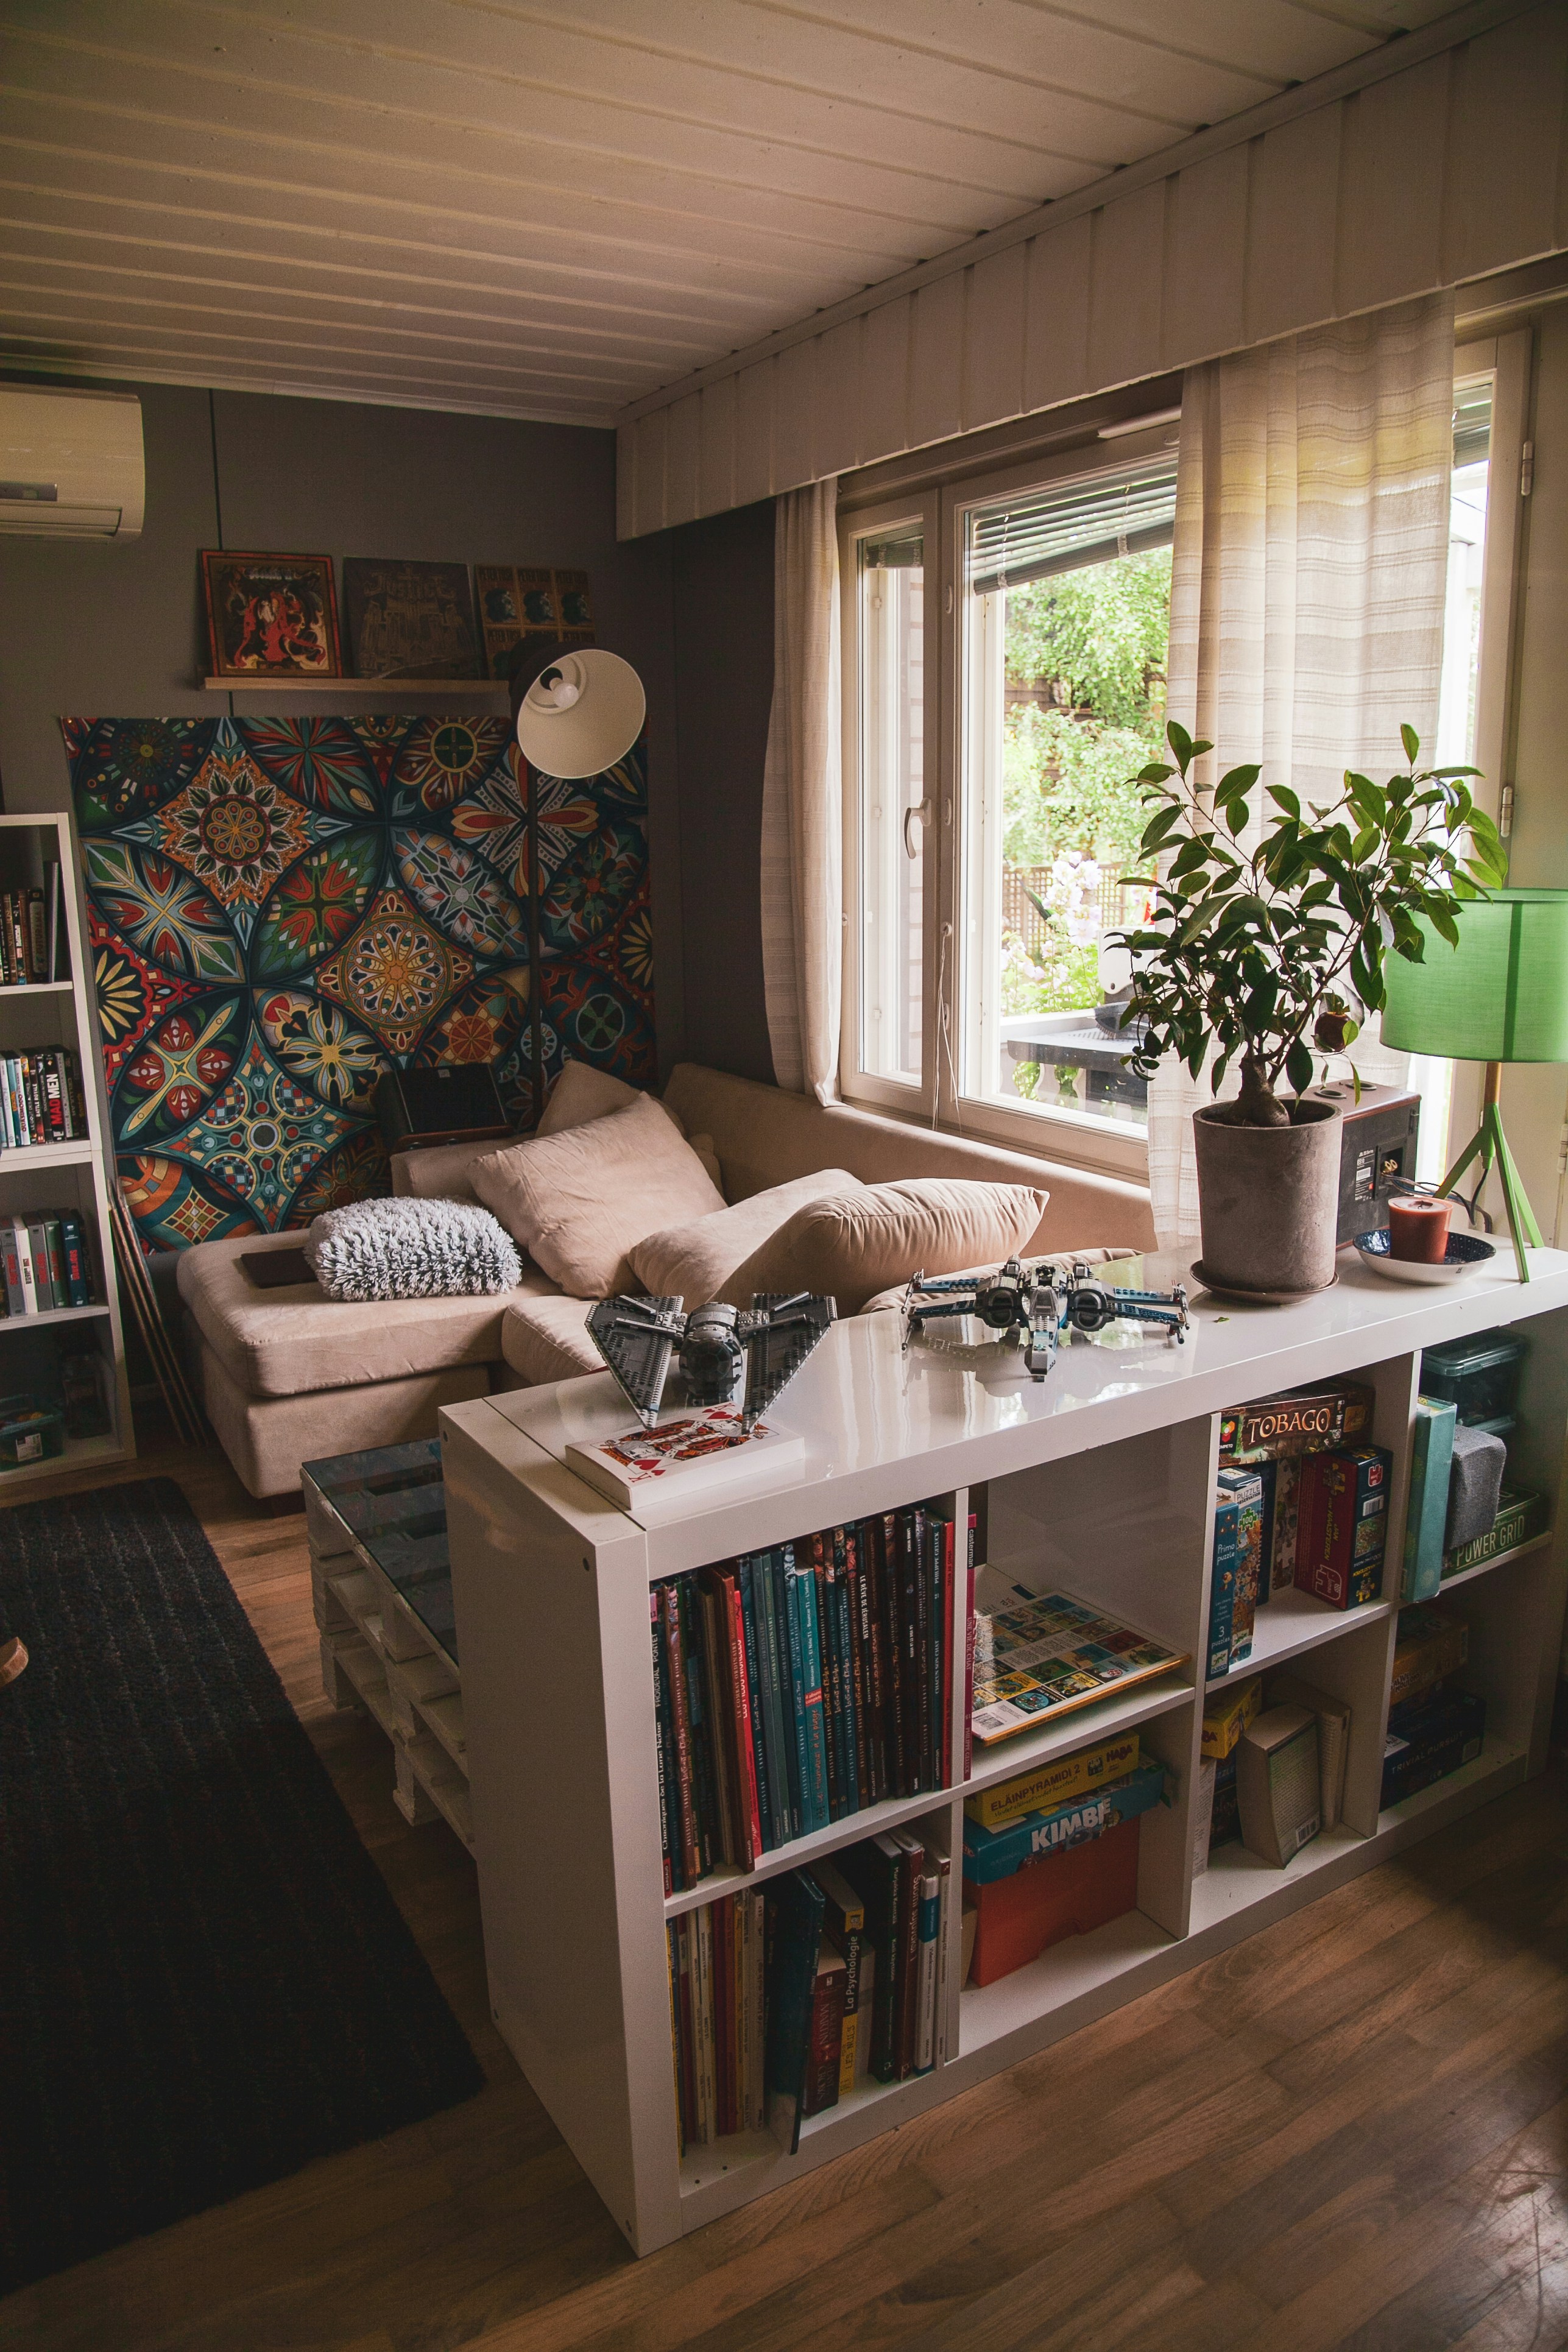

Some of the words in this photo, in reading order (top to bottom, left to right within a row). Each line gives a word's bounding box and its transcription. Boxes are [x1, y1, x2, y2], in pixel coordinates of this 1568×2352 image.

[46, 1074, 61, 1099] MEN
[18, 1094, 27, 1132] QUASIMODO
[49, 1099, 63, 1125] MAD
[1247, 1408, 1331, 1446] TOBAGO
[1237, 1485, 1260, 1500] PUZZLE
[1243, 1515, 1254, 1525] 100
[1218, 1543, 1235, 1555] Primo
[1456, 1531, 1496, 1567] POWER
[1500, 1514, 1525, 1547] GRID
[1217, 1551, 1235, 1564] puzzle
[860, 1575, 866, 1583] LE
[861, 1608, 869, 1639] JÉRUSALEM
[1218, 1625, 1225, 1637] 3
[965, 1640, 971, 1651] DE
[1211, 1637, 1231, 1648] puzzles
[872, 1654, 878, 1662] DU
[1201, 1729, 1218, 1743] BA
[1106, 1745, 1132, 1762] HABA
[1391, 1750, 1426, 1775] TRIVIAL
[1427, 1730, 1464, 1756] PURSUIT
[991, 1768, 1072, 1812] ELÄINPYRAMIDI
[1073, 1764, 1081, 1773] 2
[912, 1874, 923, 1907] Suomi
[909, 1910, 919, 1954] sujuvaksi
[846, 1936, 859, 1995] Psychologie
[844, 1997, 854, 2010] La
[818, 2002, 830, 2046] MARTIN
